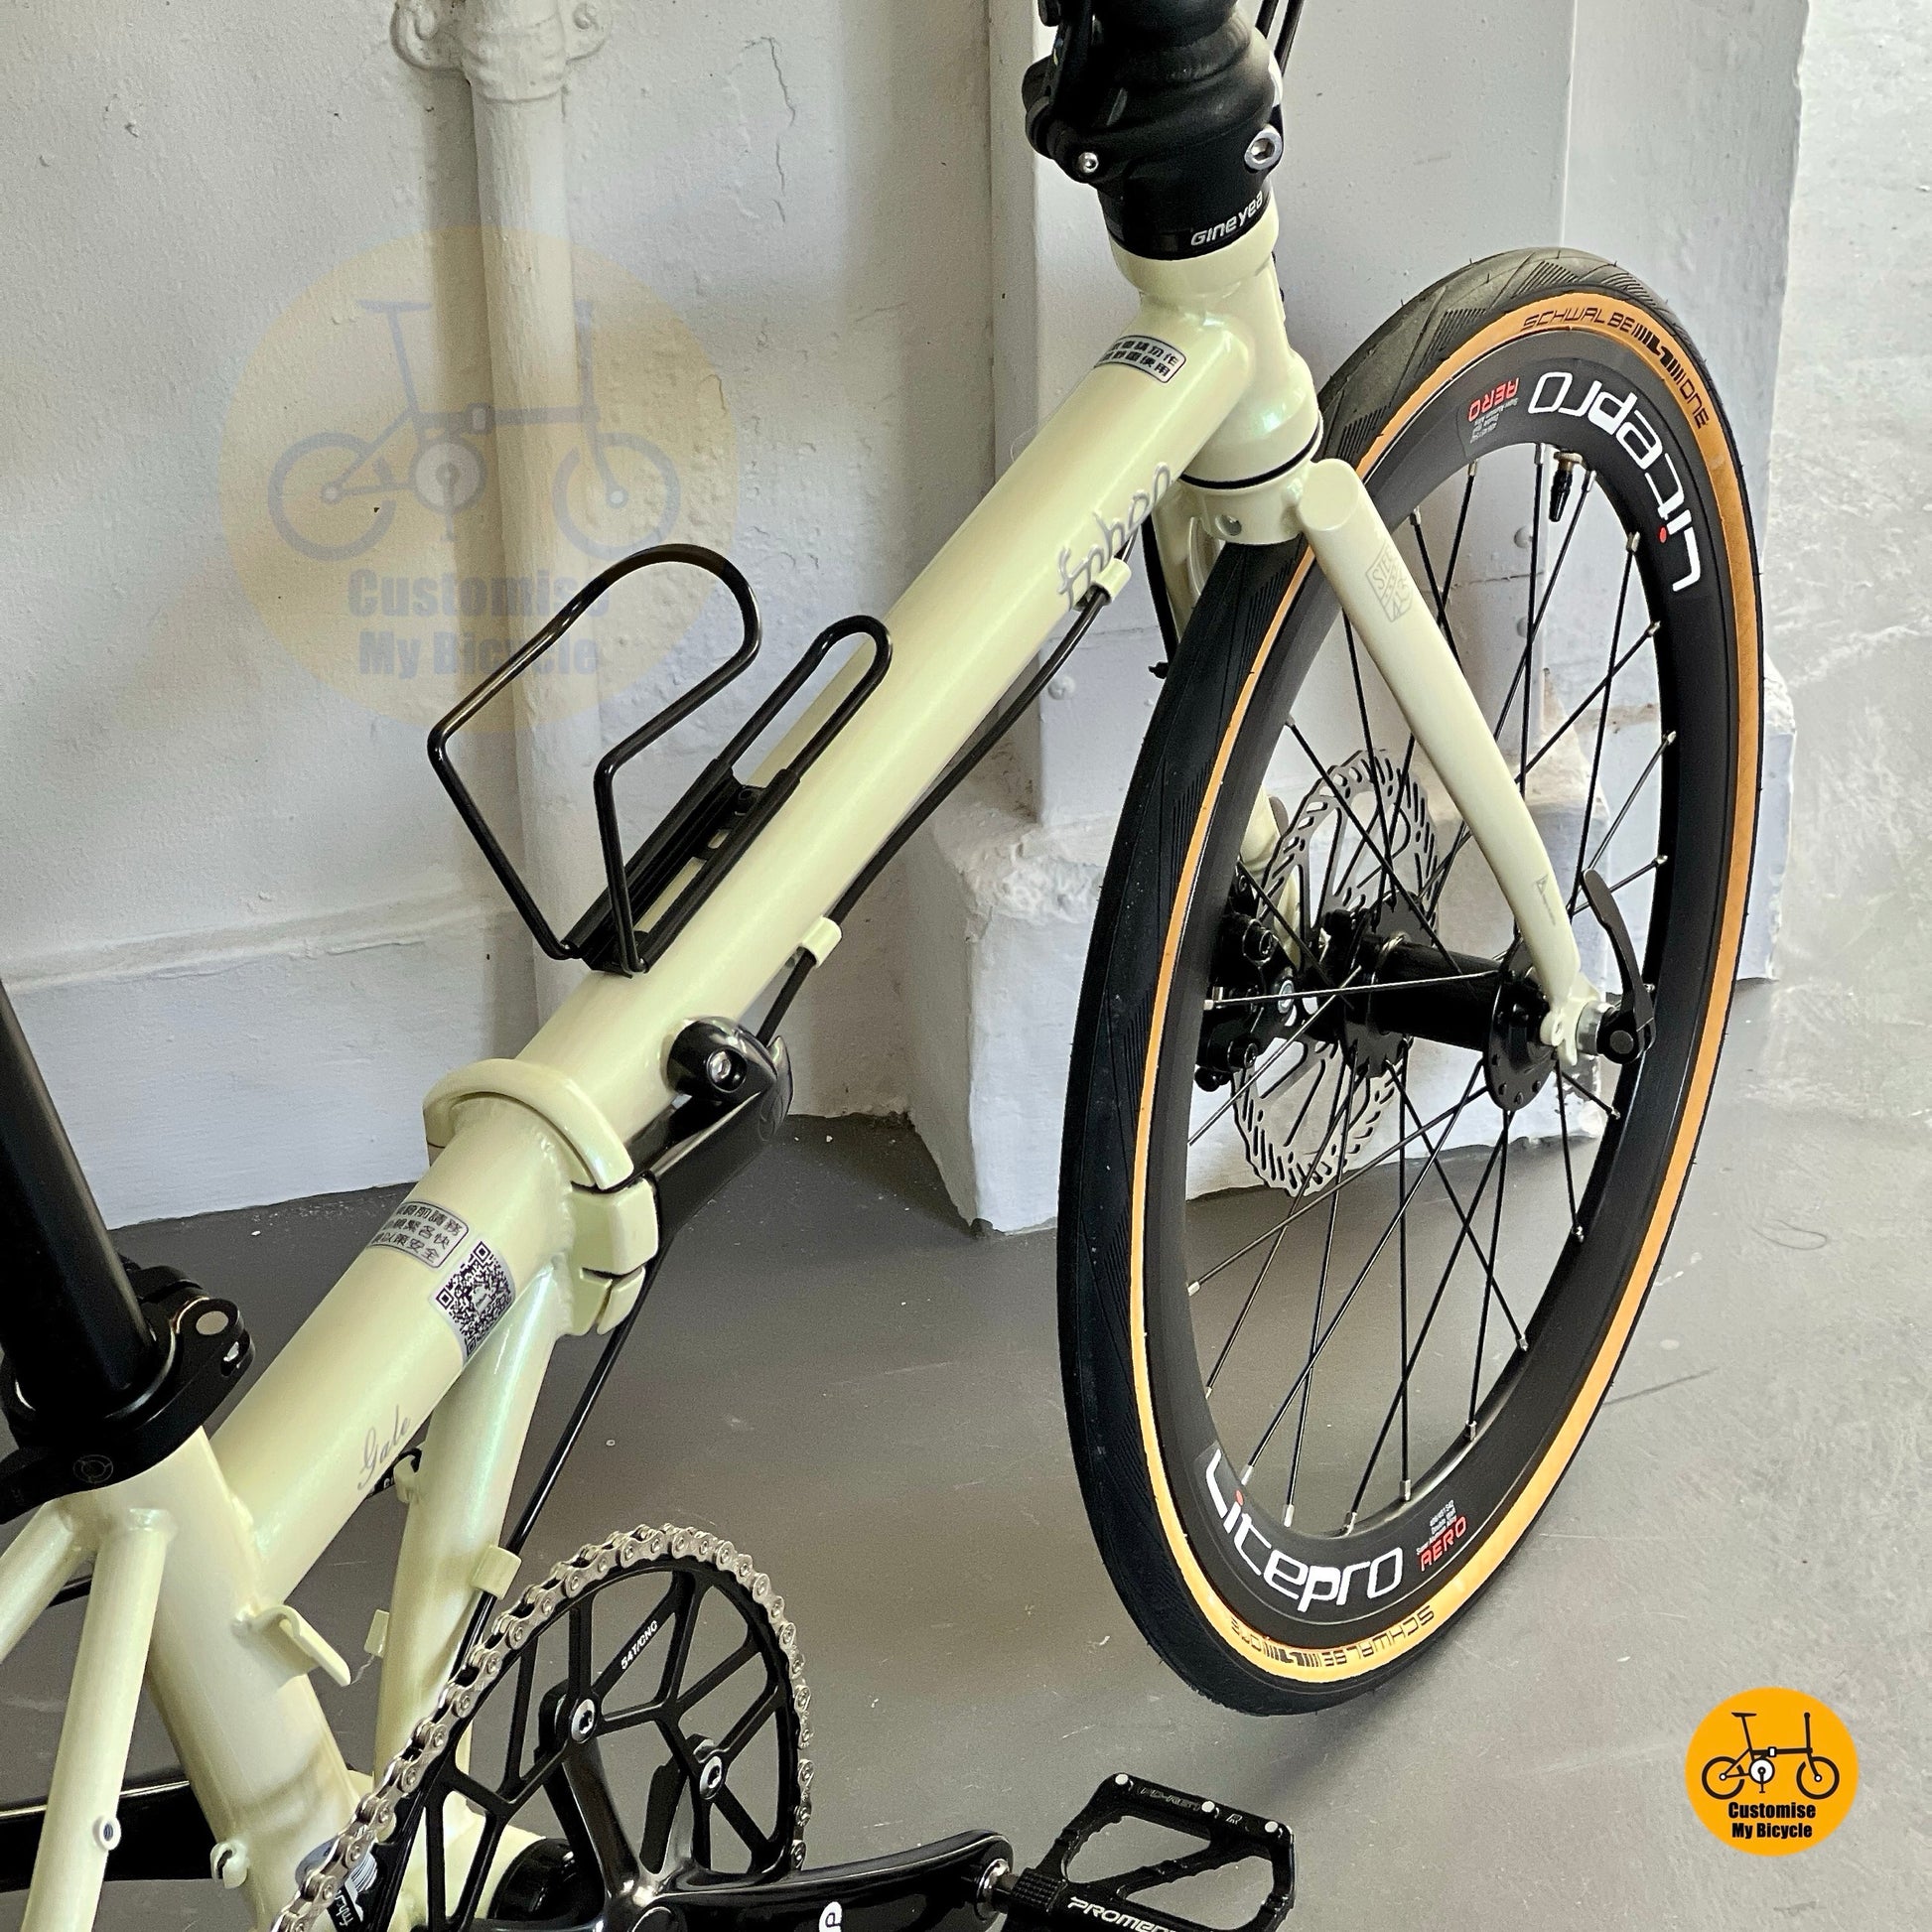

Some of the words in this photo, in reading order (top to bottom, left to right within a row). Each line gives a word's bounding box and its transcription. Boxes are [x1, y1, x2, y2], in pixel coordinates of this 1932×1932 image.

[1468, 377, 1520, 422] AERO
[1521, 307, 1635, 336] SCHWALBE
[1683, 377, 1711, 430] ONE
[357, 1404, 410, 1491] Gale
[1421, 1516, 1466, 1572] AERO
[1321, 1604, 1435, 1666] SCHWALBE
